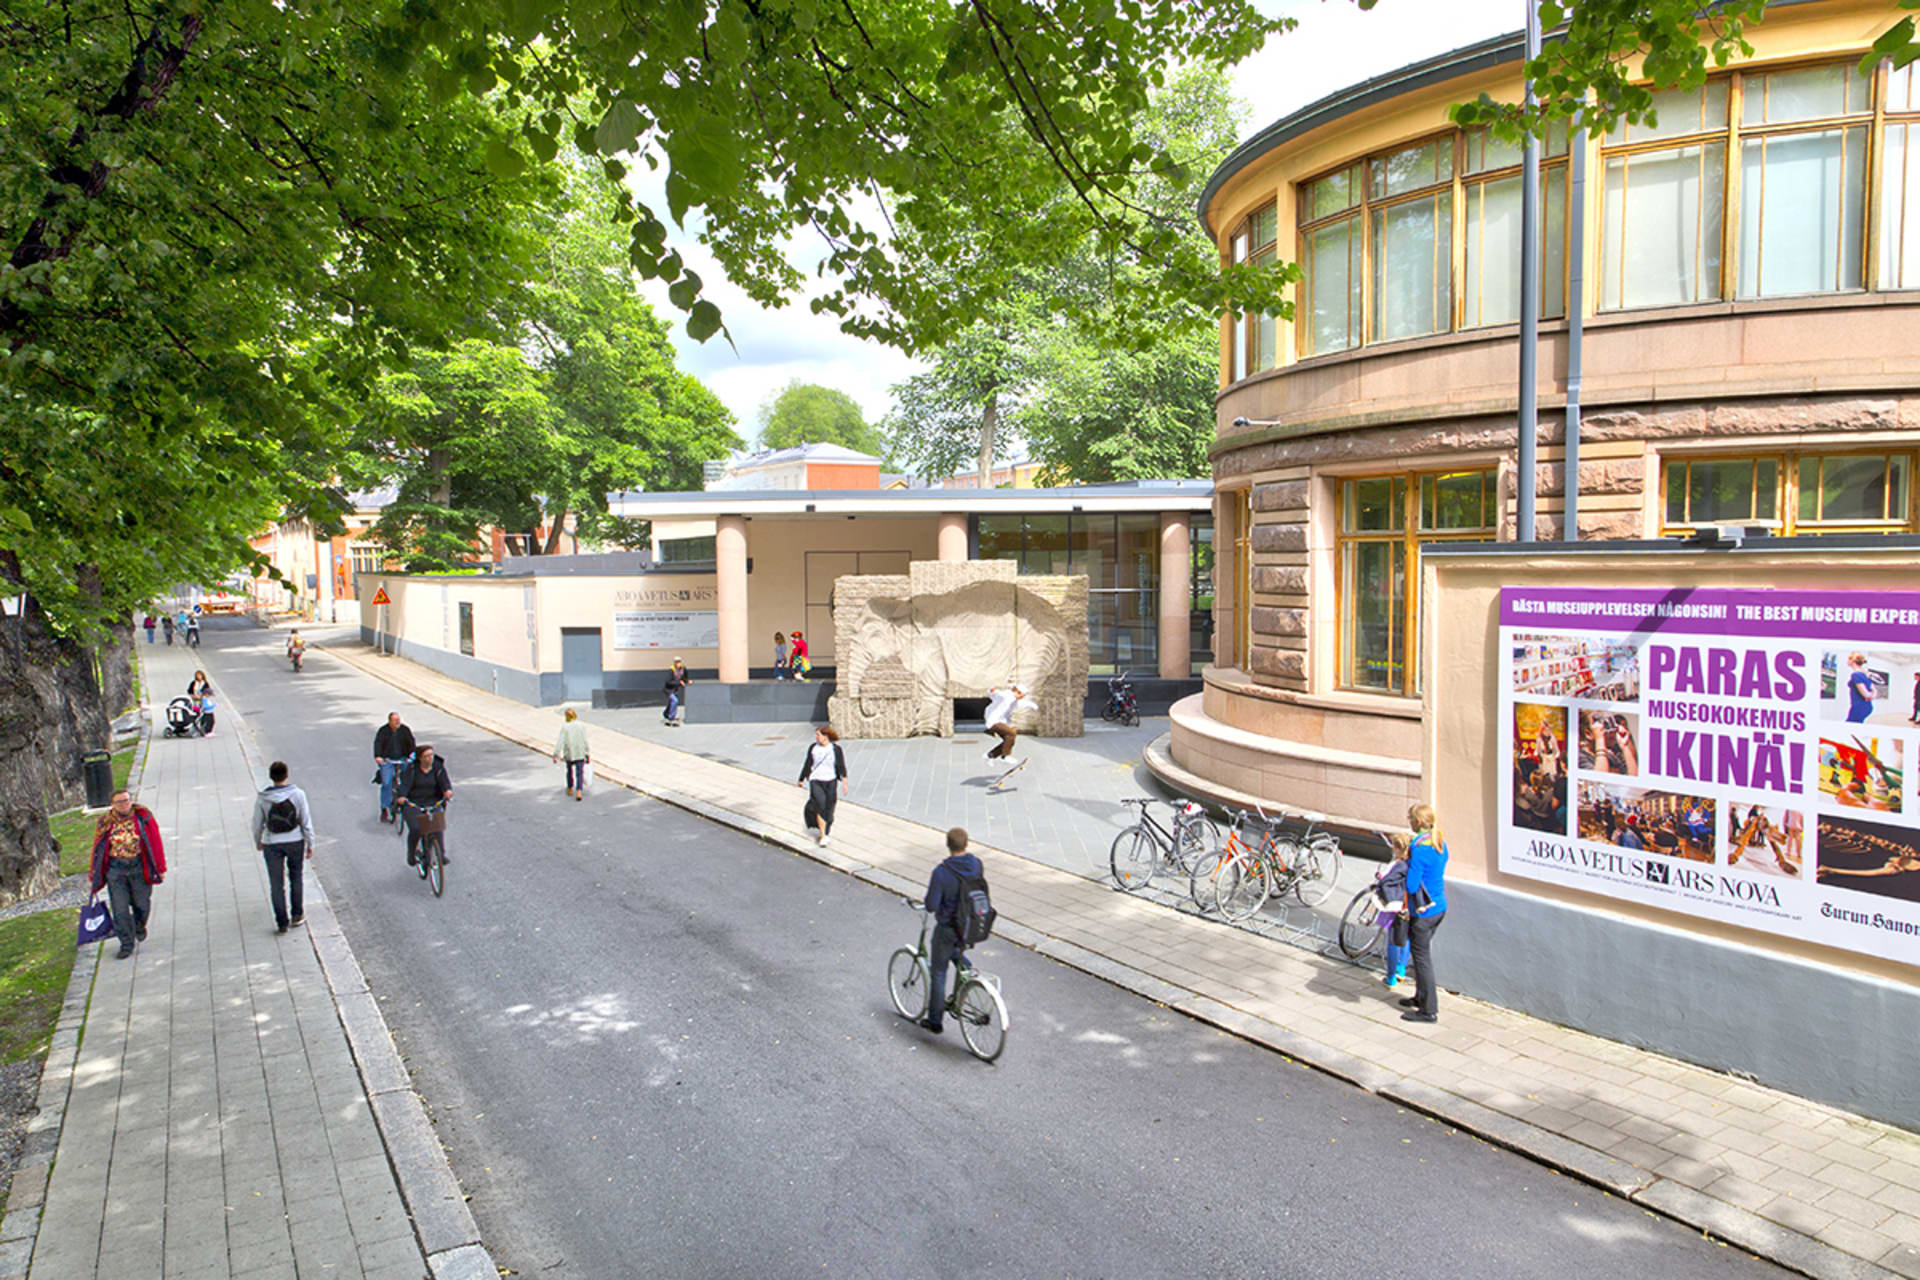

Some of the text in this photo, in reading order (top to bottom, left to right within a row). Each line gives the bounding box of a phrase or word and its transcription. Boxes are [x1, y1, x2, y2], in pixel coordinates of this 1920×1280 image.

[1512, 599, 1727, 619] BÄSTA MUSEIUPPLEVELSEN NÅGONSIN!
[1736, 605, 1761, 620] THE
[1763, 606, 1799, 621] BEST
[1801, 606, 1867, 623] MUSEUM
[1649, 644, 1806, 702] PARAS
[1648, 699, 1806, 732] MUSEOKOKEMUS
[1649, 727, 1805, 794] IKINÄ!
[1526, 839, 1576, 865] ABOA
[1579, 847, 1644, 879] VETUS
[1671, 867, 1715, 893] ARS
[1720, 876, 1781, 907] NOVA
